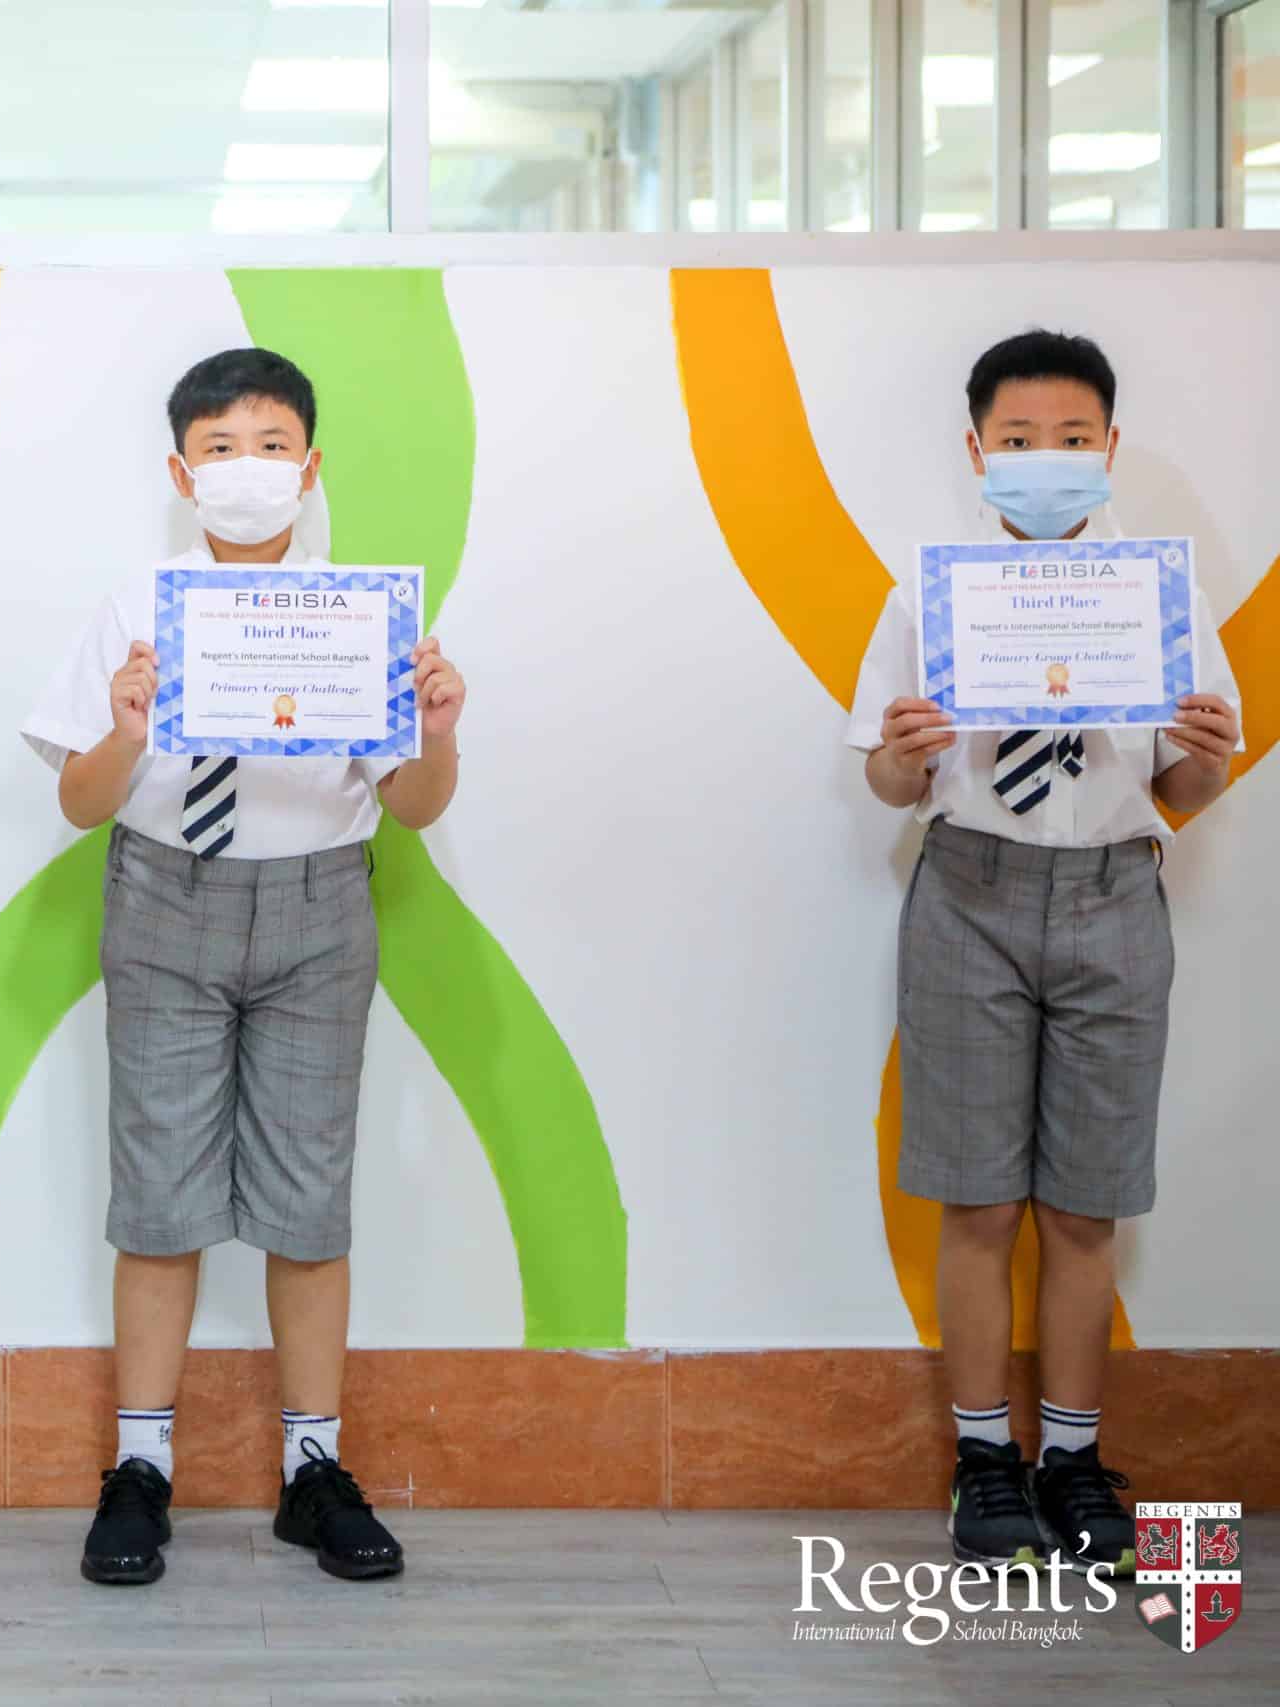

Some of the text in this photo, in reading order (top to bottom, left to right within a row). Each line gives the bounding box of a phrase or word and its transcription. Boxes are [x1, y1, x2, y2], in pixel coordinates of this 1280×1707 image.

[1011, 595, 1101, 609] Third Place
[241, 625, 331, 640] Third Place
[970, 620, 1142, 632] Regent's International School Bangkok
[201, 651, 371, 663] Regent's International School Bangkok
[980, 652, 1033, 664] Primary
[1075, 650, 1137, 663] Challenge
[210, 682, 362, 696] Primary Group Challenge
